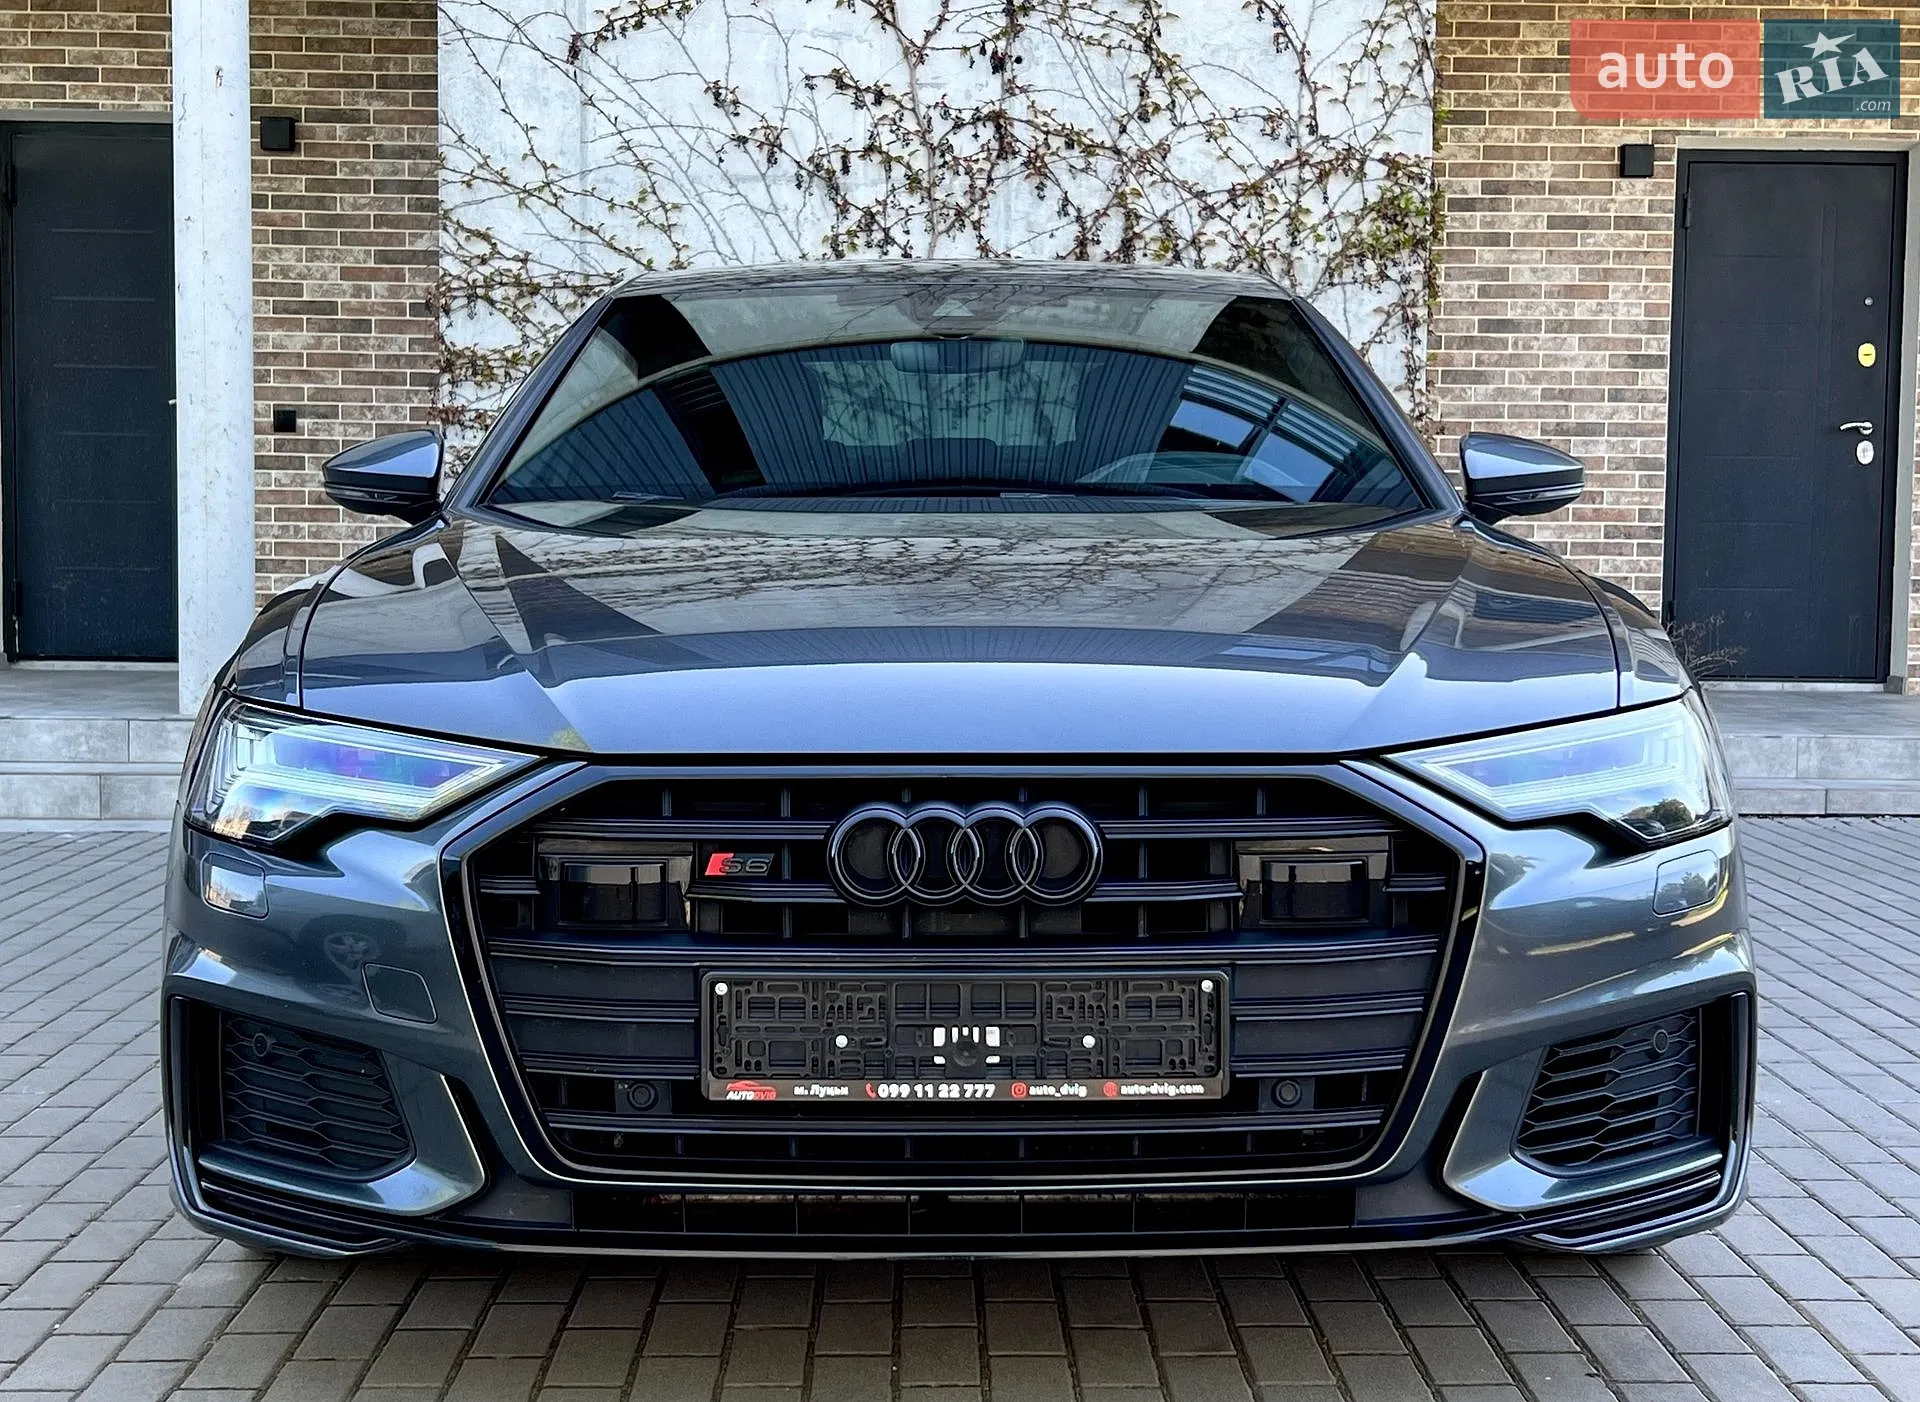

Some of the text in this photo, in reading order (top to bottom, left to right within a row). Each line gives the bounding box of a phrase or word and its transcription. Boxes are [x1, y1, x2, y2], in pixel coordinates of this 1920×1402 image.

[719, 857, 770, 873] S6
[877, 1083, 996, 1099] 099 11 22 777
[1028, 1083, 1088, 1098] auto_dvig
[1120, 1082, 1205, 1098] auto-dvig.com
